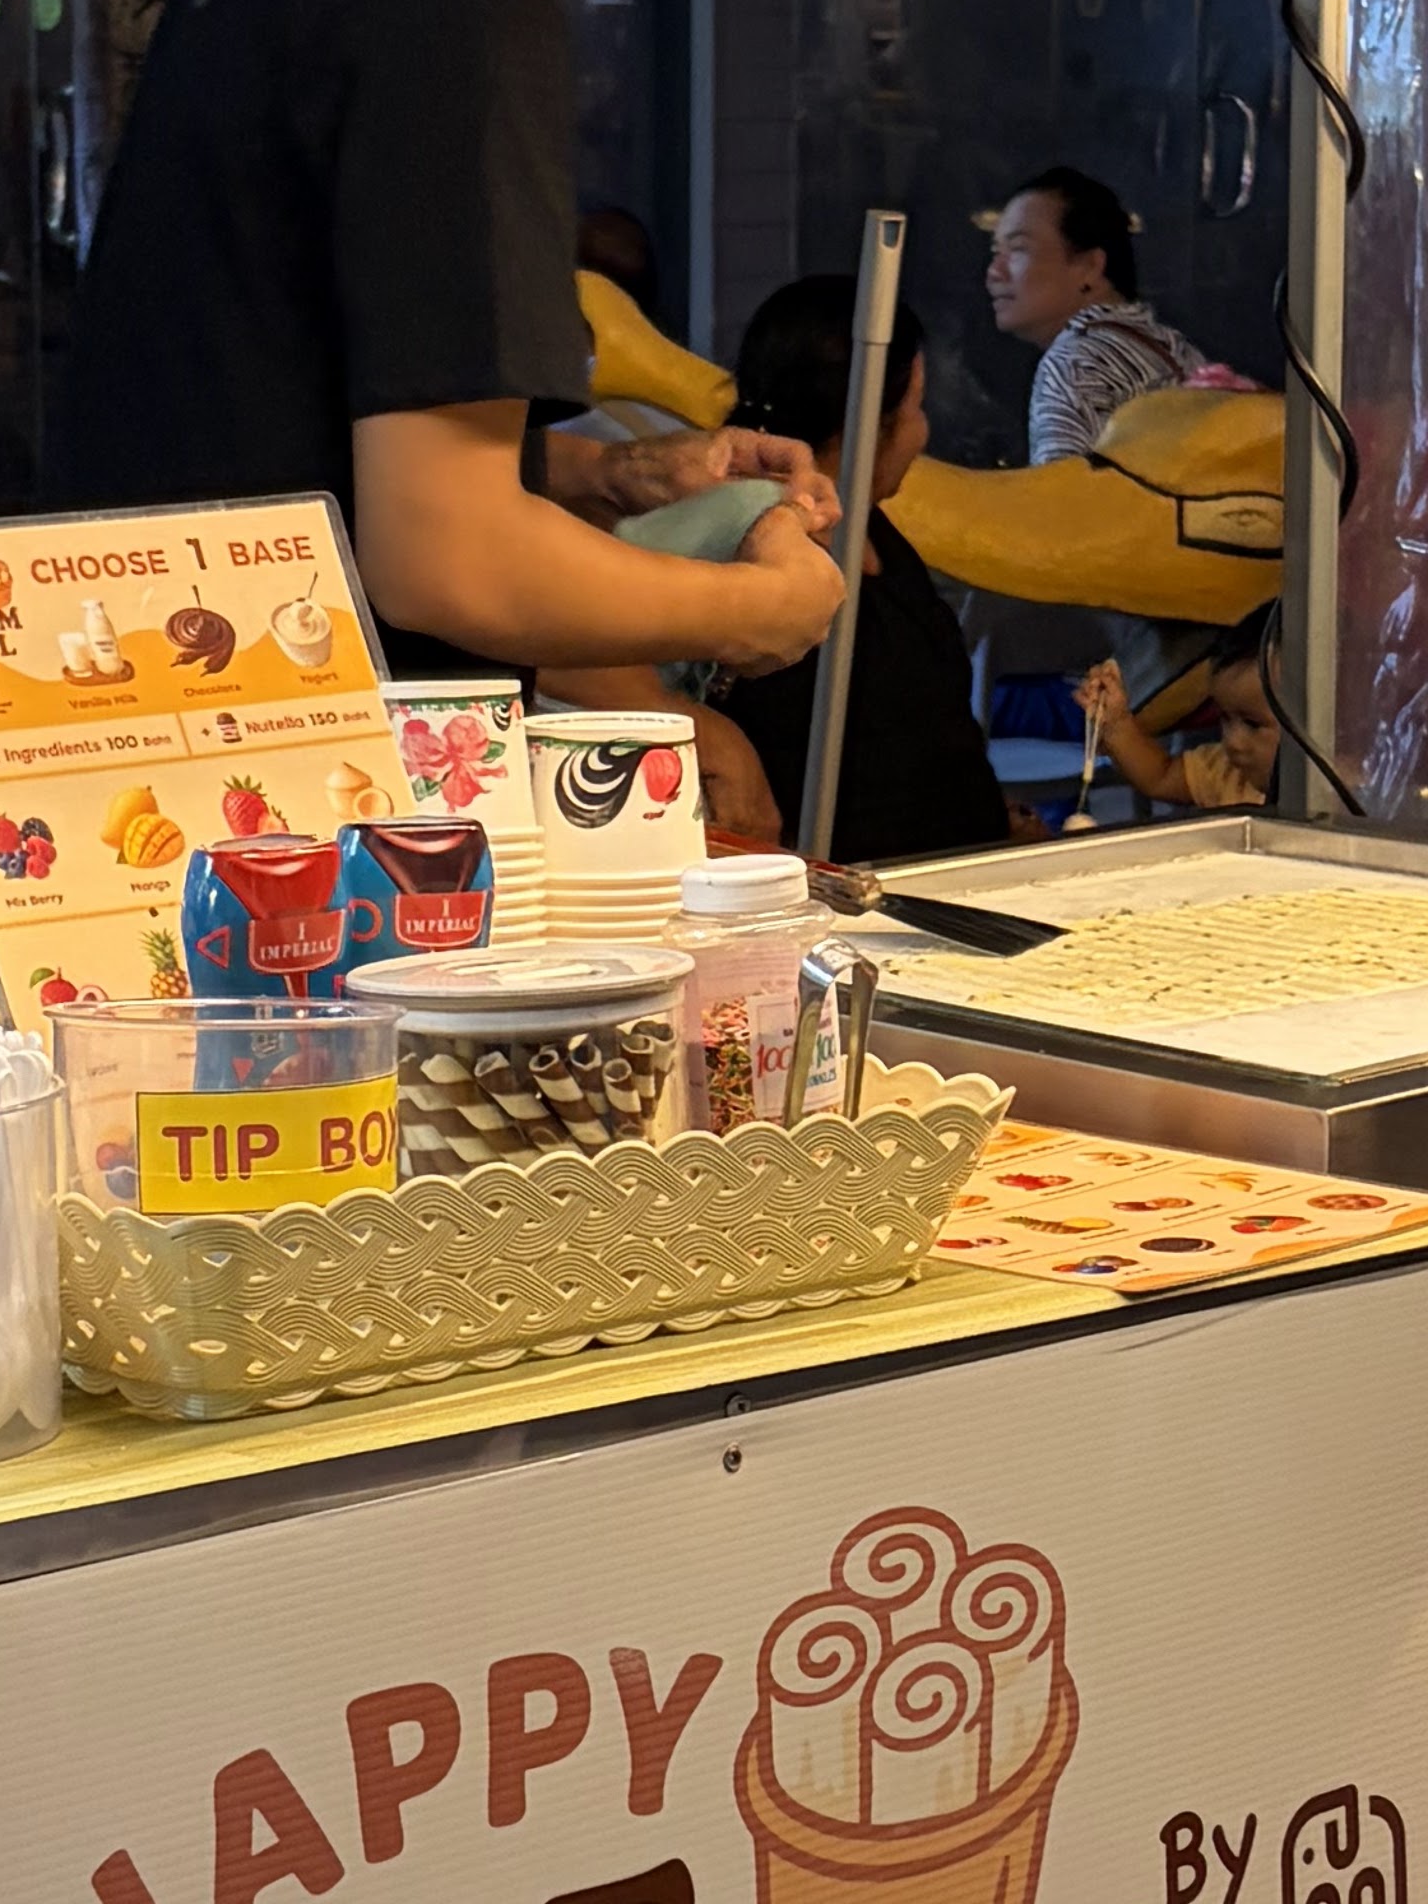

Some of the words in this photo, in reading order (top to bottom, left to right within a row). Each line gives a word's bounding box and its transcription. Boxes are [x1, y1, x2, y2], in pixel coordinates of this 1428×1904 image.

[31, 550, 169, 584] CHOOSE
[186, 538, 207, 570] 1
[228, 536, 315, 567] BASE
[245, 718, 305, 734] Nutella
[308, 711, 339, 726] 150
[3, 739, 102, 764] Ingredients
[106, 735, 139, 751] 100
[30, 894, 64, 906] Berry
[404, 916, 478, 934] IMPERIAL
[260, 935, 336, 961] IMPERIAL
[162, 1124, 280, 1182] TIP
